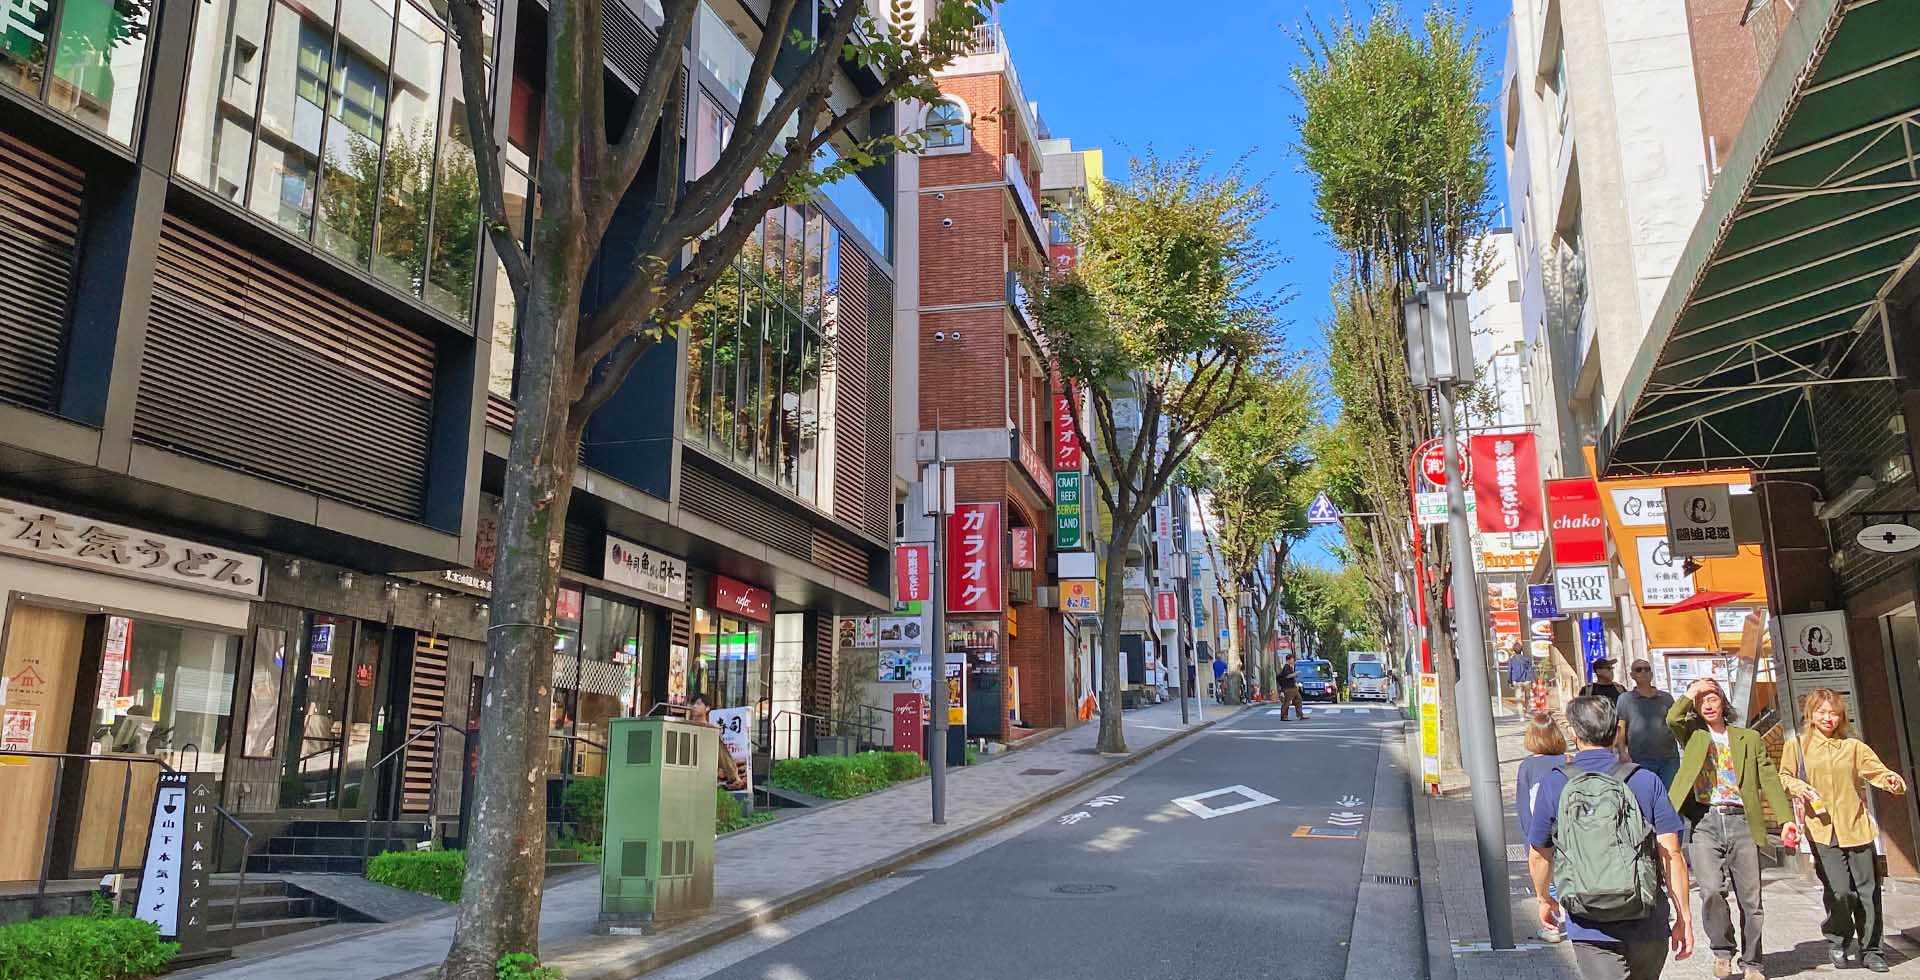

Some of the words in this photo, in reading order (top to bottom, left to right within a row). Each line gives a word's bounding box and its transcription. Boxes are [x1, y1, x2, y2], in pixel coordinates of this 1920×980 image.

[1057, 477, 1078, 488] CRAFT
[1061, 491, 1077, 501] BEER
[1059, 518, 1078, 529] LAND
[1553, 513, 1601, 529] chako
[961, 510, 987, 606] カラオケ
[1561, 576, 1605, 590] SHOT
[1568, 588, 1603, 602] BAR
[1066, 596, 1090, 610] 松屋
[188, 803, 206, 926] 山下本気うどん
